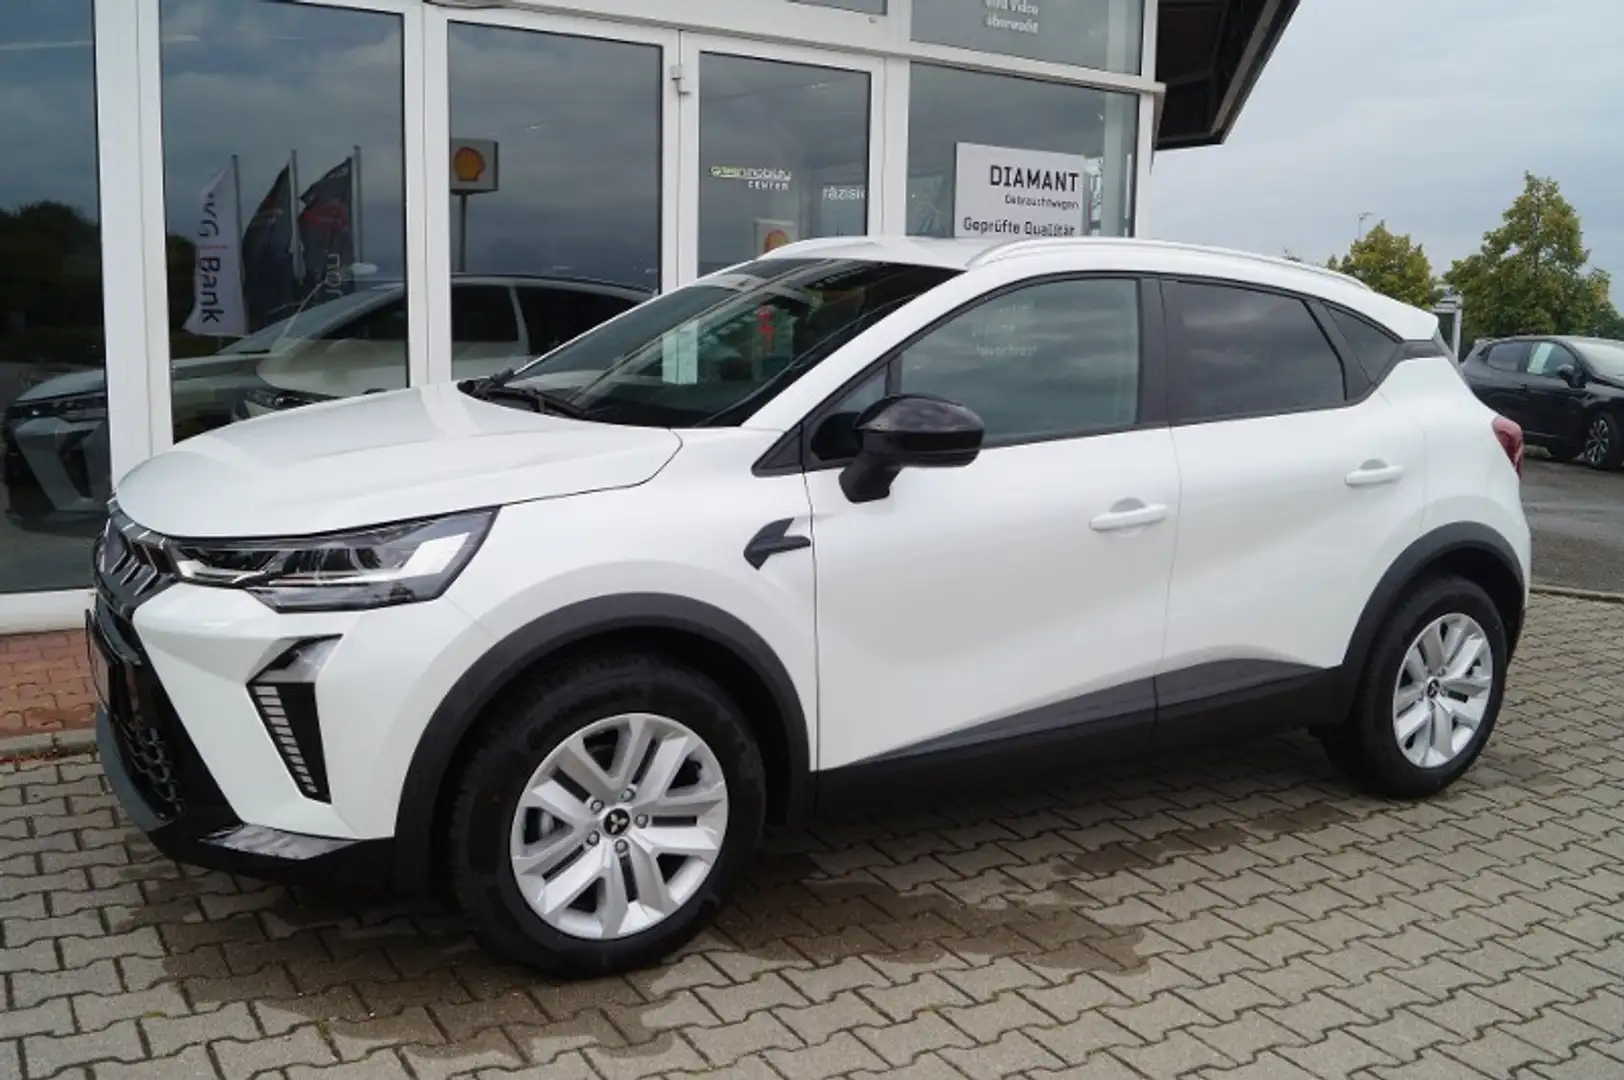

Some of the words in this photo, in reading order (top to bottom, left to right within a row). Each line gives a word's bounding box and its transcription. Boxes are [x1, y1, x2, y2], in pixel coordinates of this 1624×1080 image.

[990, 165, 1079, 192] DIAMANT
[963, 216, 1021, 235] Geprüfte
[1024, 221, 1076, 238] Qualität
[200, 257, 224, 323] Bank
